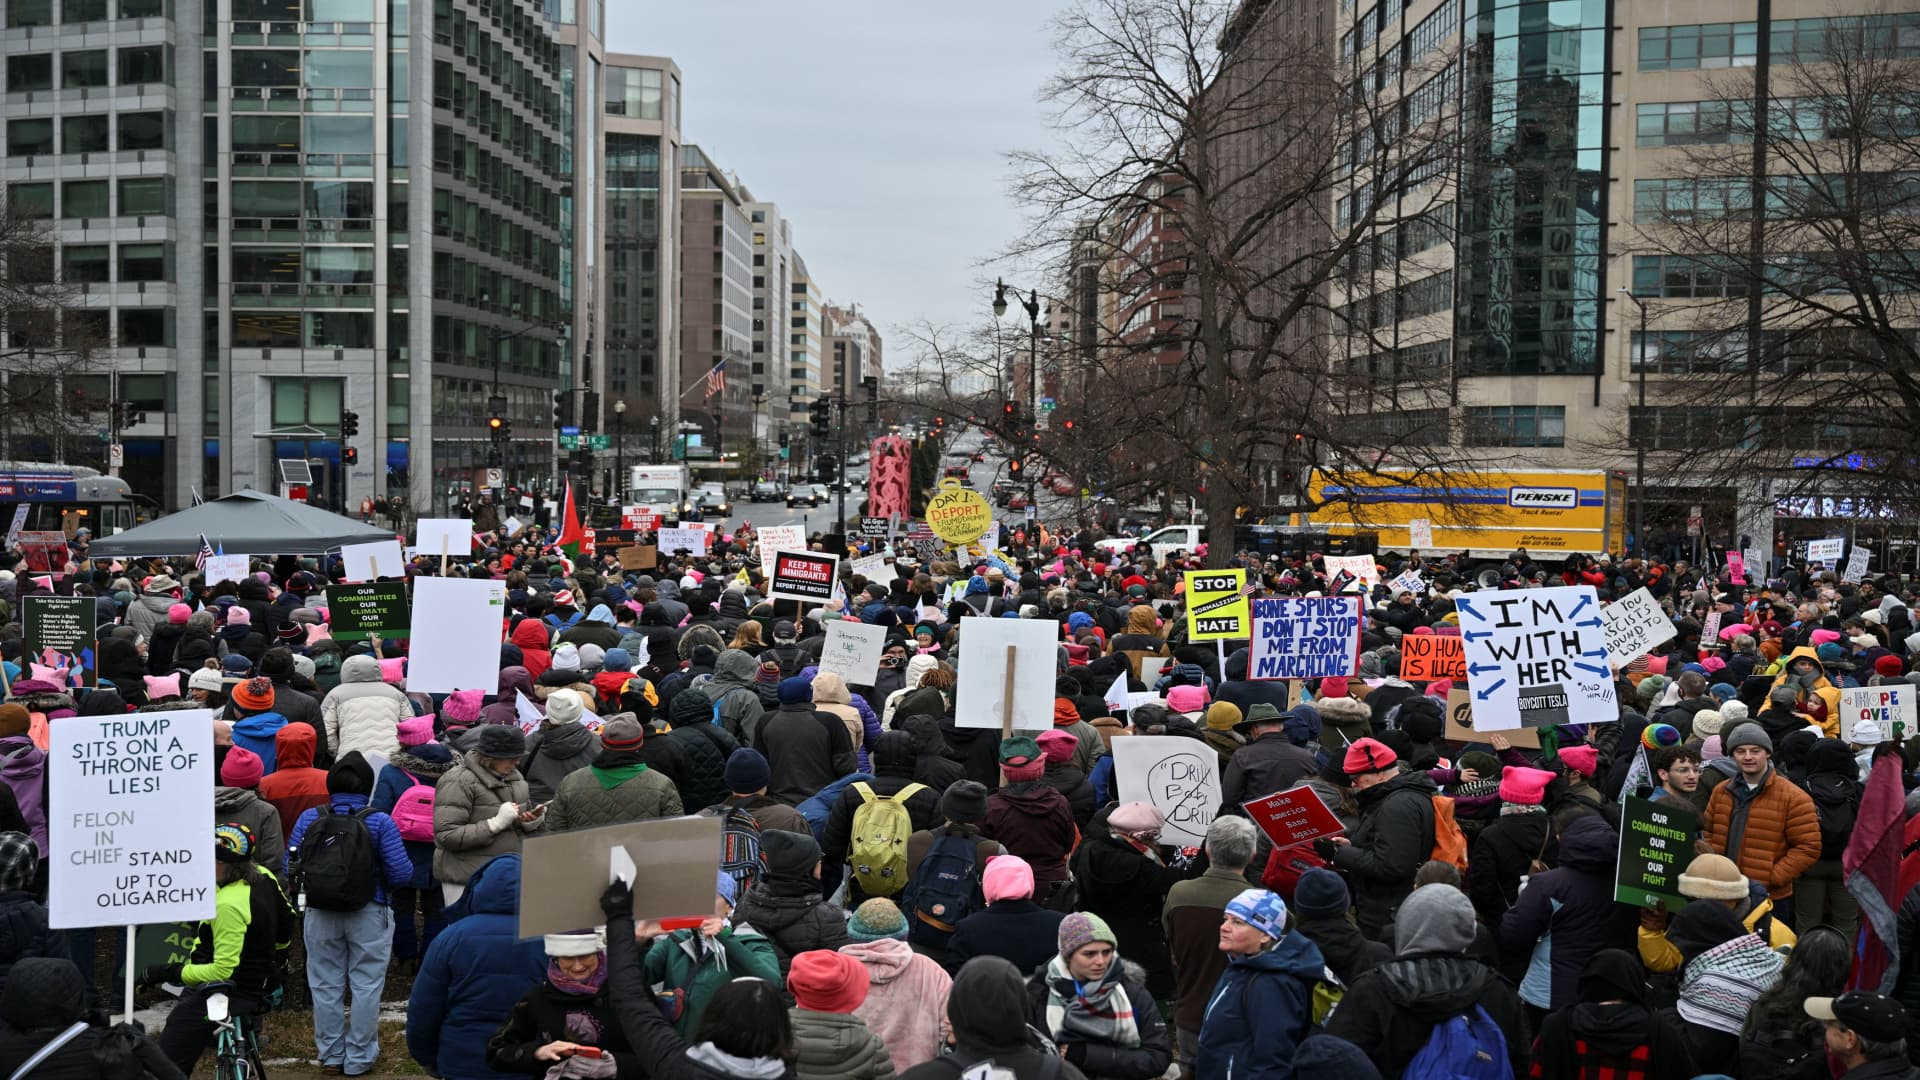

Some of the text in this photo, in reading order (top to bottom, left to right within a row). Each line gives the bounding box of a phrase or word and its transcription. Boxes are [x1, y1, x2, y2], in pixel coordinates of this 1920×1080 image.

[935, 492, 959, 508] DAY
[1515, 493, 1572, 502] PENSKE
[931, 505, 980, 522] DEPORT
[788, 559, 823, 571] KEEP THE
[782, 568, 827, 580] IMMIGRANTS
[1194, 578, 1236, 590] STOP
[337, 594, 397, 602] COMMUNITIES
[1621, 595, 1642, 611] YOU
[1254, 598, 1348, 619] BONE SPURS
[1490, 596, 1563, 629] I'M
[1197, 620, 1239, 631] HATE
[1263, 617, 1358, 638] DON'T STOP
[1607, 617, 1661, 653] BOUND TO
[1267, 637, 1346, 654] ME FROM
[1405, 638, 1430, 657] NO
[1484, 630, 1582, 661] WITH
[1257, 654, 1348, 677] MARCHING
[1403, 660, 1424, 676] IS
[1518, 695, 1568, 710] BOYCOTT TESLA
[1855, 691, 1898, 708] HOPE
[1860, 706, 1901, 720] OVER
[100, 719, 170, 738] TRUMP
[72, 736, 183, 759] SITS ON A
[79, 753, 199, 777] THRONE OF
[109, 776, 160, 795] LIES!
[1266, 797, 1292, 808] Make
[73, 810, 134, 828] FELON
[1270, 806, 1307, 820] America
[1652, 813, 1668, 825] OUR
[1285, 818, 1308, 829] Sane
[1631, 820, 1686, 841] COMMUNITIES
[95, 831, 114, 846] IN
[1291, 827, 1320, 840] Again
[1650, 837, 1666, 849] OUR
[70, 848, 192, 866] CHIEF STAND
[1639, 847, 1674, 863] CLIMATE
[1648, 862, 1663, 873] OUR
[116, 874, 173, 890] UP TO
[1642, 873, 1666, 887] FIGHT
[96, 888, 207, 908] OLIGARCHY
